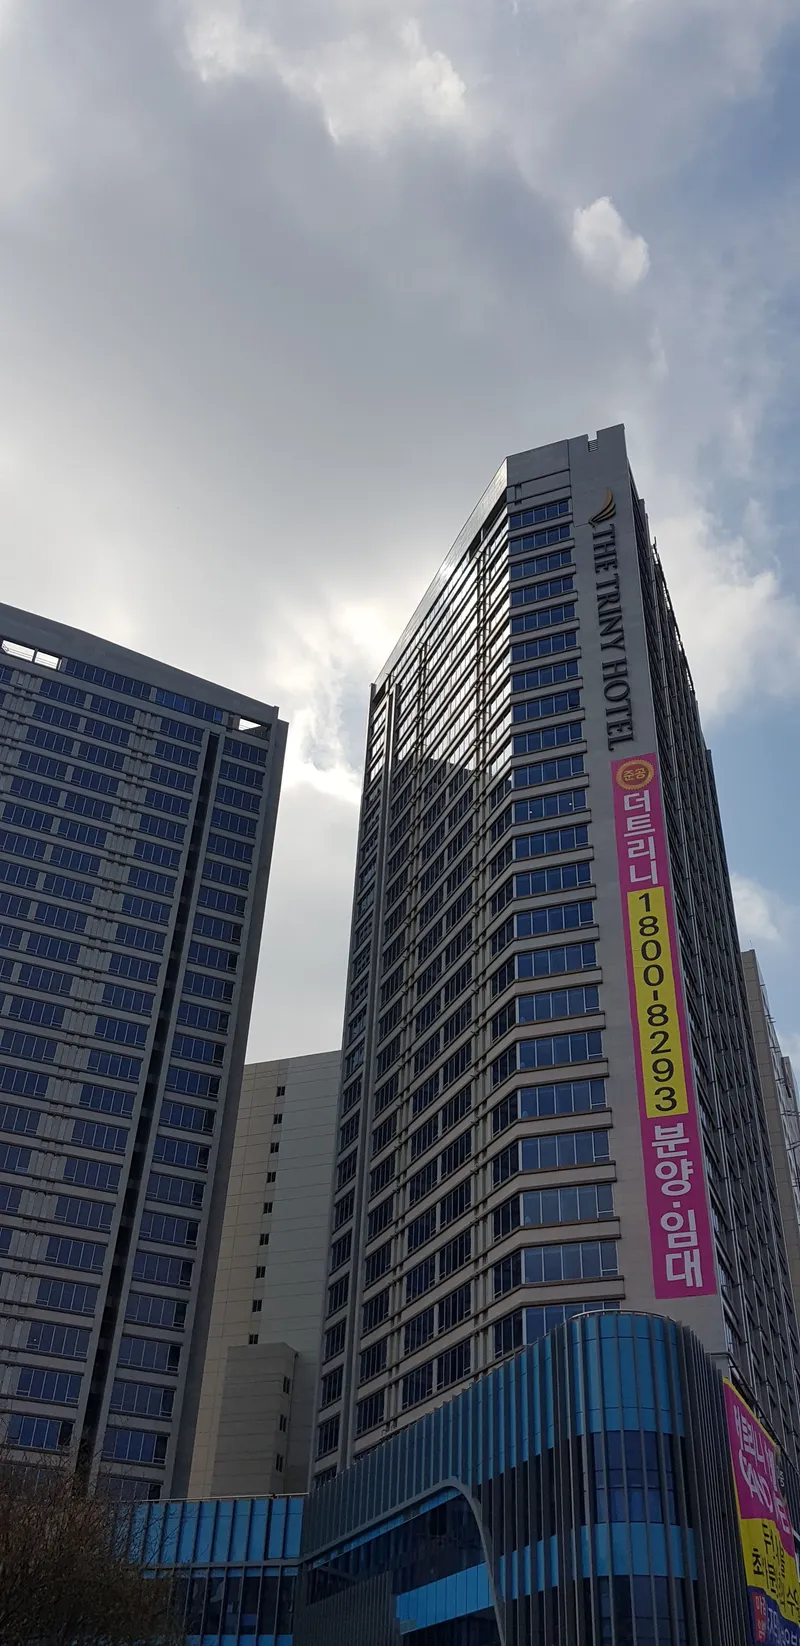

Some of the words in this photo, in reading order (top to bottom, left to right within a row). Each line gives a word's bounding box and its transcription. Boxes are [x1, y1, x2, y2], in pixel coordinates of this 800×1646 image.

[592, 523, 618, 573] THE
[597, 576, 626, 651] TRINY
[602, 658, 634, 752] HOTEL
[623, 768, 647, 782] 준공
[623, 790, 659, 885] 더트리니
[638, 892, 679, 1113] 1800-8293
